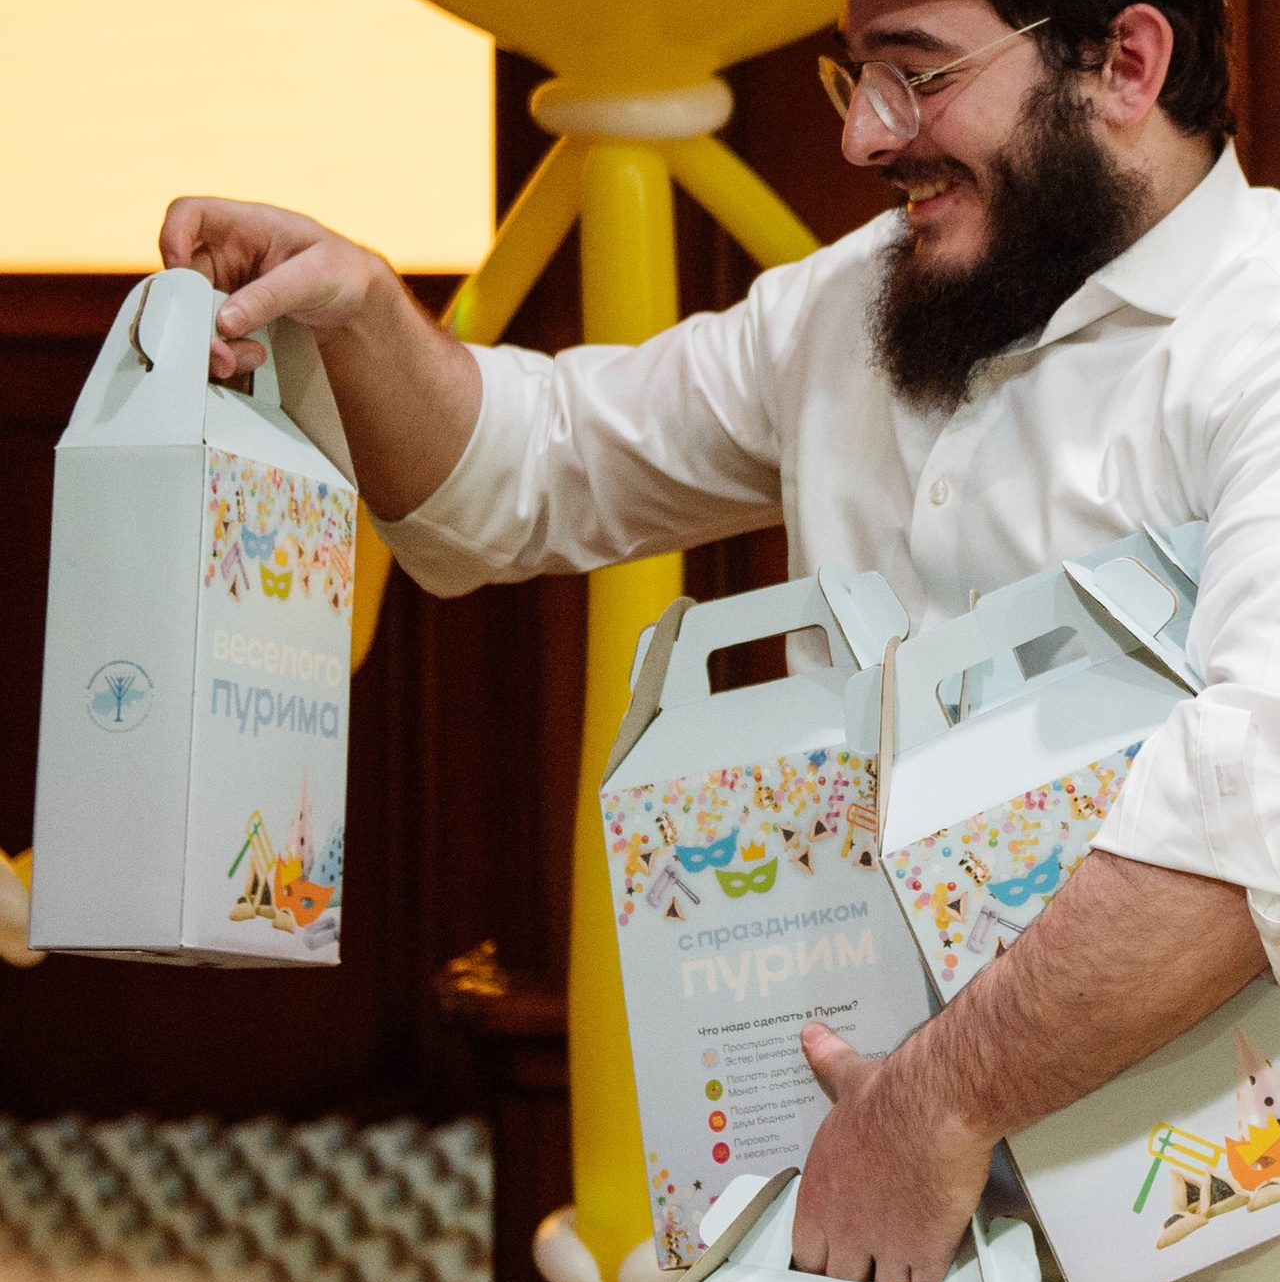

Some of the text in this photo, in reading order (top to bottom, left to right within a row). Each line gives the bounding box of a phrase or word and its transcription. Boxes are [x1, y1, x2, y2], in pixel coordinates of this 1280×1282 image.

[213, 629, 342, 687] веселого
[211, 678, 339, 740] пурима
[677, 901, 870, 951] с праздником
[681, 928, 875, 1003] пурим
[697, 1000, 859, 1038] Что надо сделать в Пурим?
[722, 1035, 786, 1054] Прослушать
